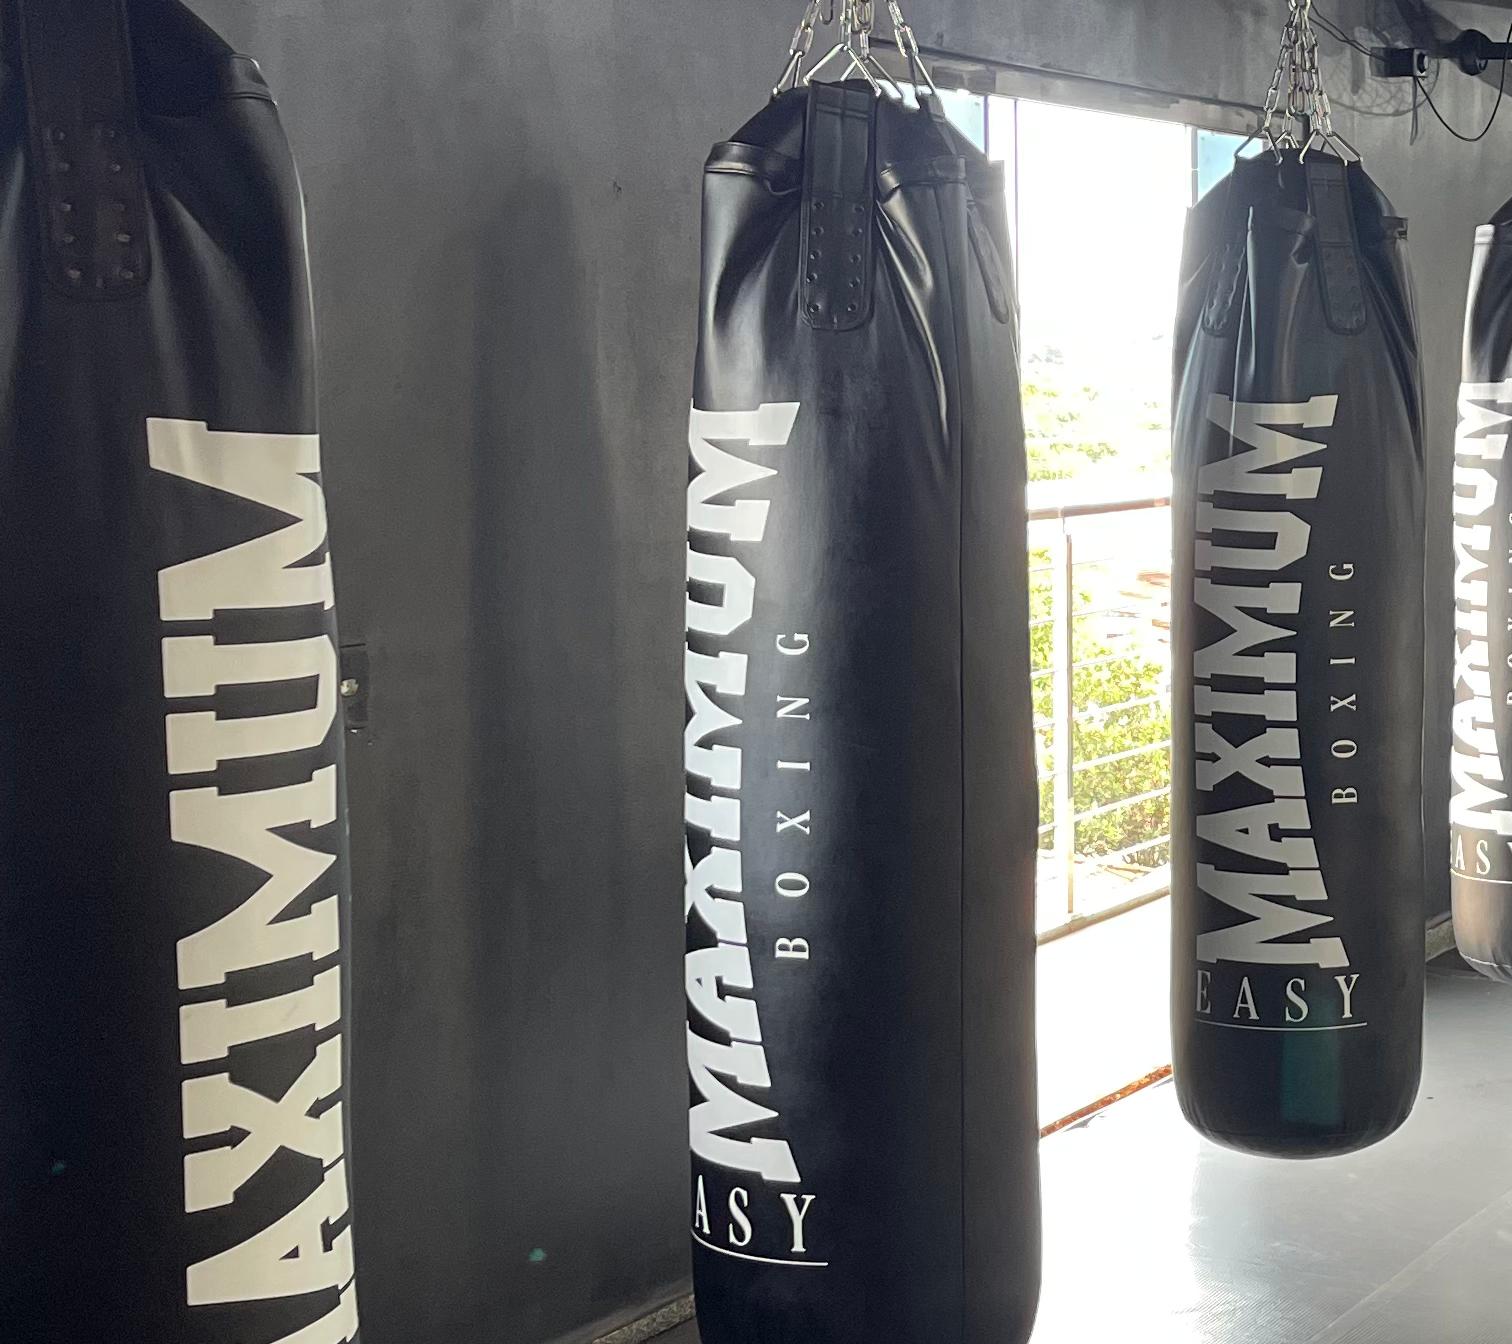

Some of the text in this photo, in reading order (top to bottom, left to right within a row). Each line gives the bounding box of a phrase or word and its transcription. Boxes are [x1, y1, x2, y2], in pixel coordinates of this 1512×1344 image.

[685, 397, 802, 1183] MAXIMUM
[774, 629, 811, 962] BOXING
[1194, 393, 1350, 969] MAXIMUM
[1328, 560, 1359, 806] BOXING
[1196, 970, 1360, 1023] EASY
[694, 1174, 816, 1253] ASY
